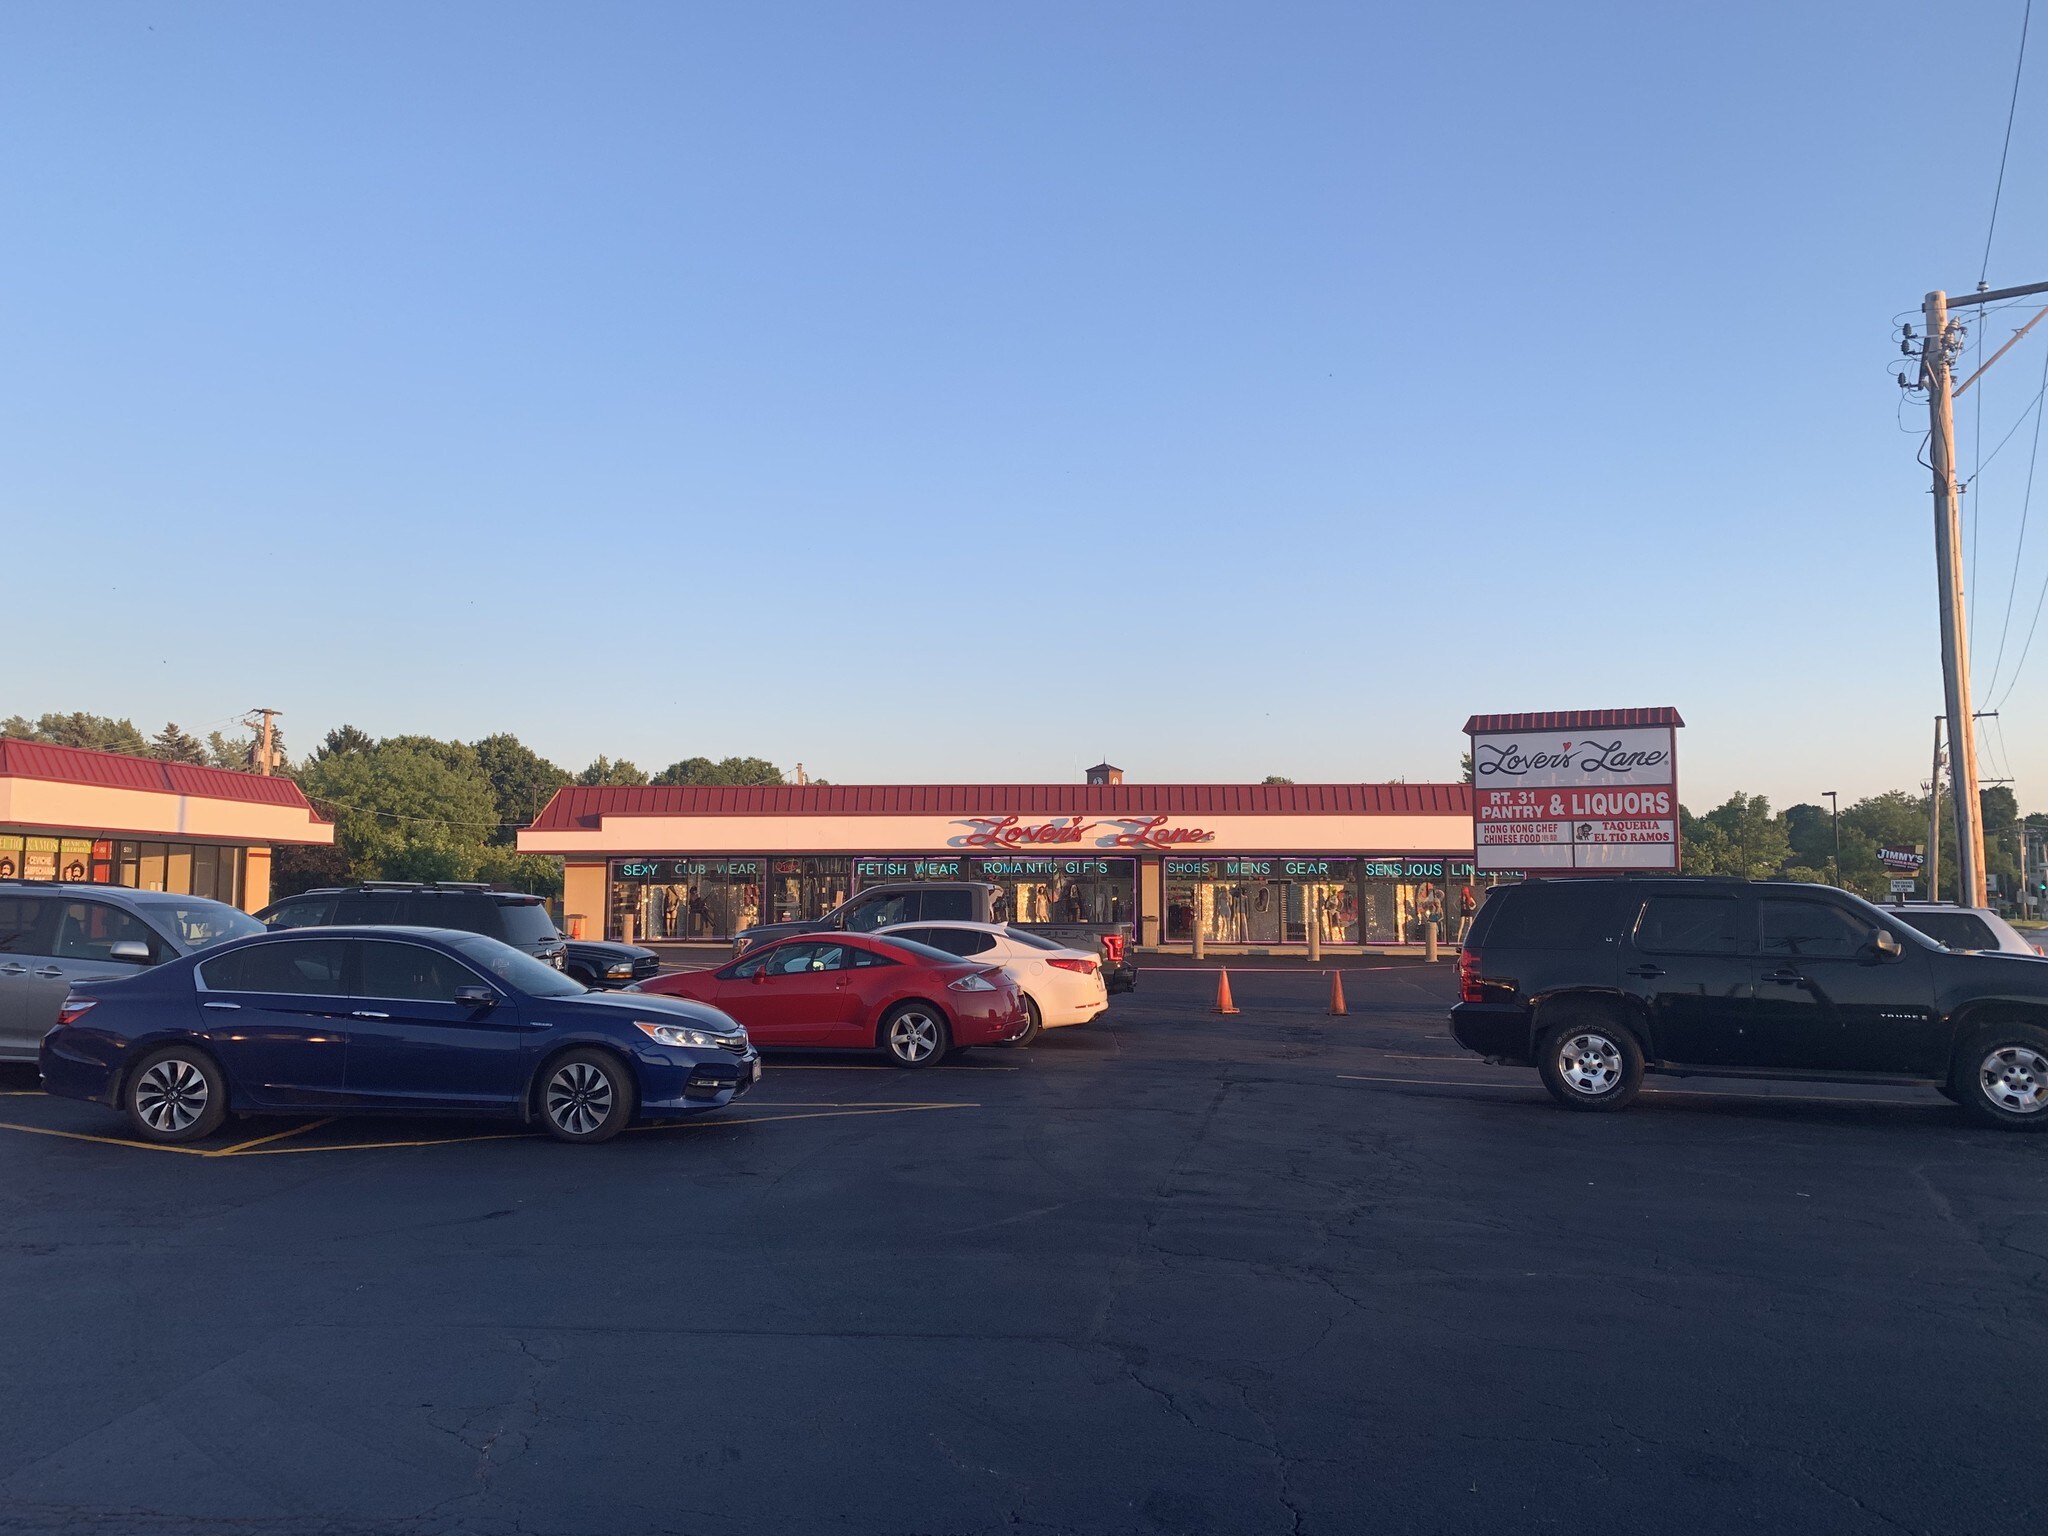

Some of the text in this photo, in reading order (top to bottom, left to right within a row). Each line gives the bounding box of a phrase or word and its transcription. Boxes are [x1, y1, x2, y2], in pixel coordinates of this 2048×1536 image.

[1477, 740, 1669, 775] Lover's Lane
[1490, 791, 1536, 805] RT. 31
[1549, 792, 1670, 817] & LIQUORS
[1481, 805, 1544, 819] PANTRY
[1484, 823, 1558, 834] HONG KONG CHEF
[1602, 820, 1660, 831] TAQUERIA
[966, 815, 1214, 850] Lover's Lane
[1484, 834, 1541, 844] CHINESE FOOD
[1594, 832, 1670, 842] EL TIO RAMOS
[1877, 848, 1924, 864] JIMMY'S
[623, 863, 757, 876] SEXY CLUB WEAR
[857, 863, 959, 876] FETISH WEAR
[983, 862, 1108, 874] ROMANTIC GIFTS
[1168, 862, 1329, 875] SHOES MENS GEAR
